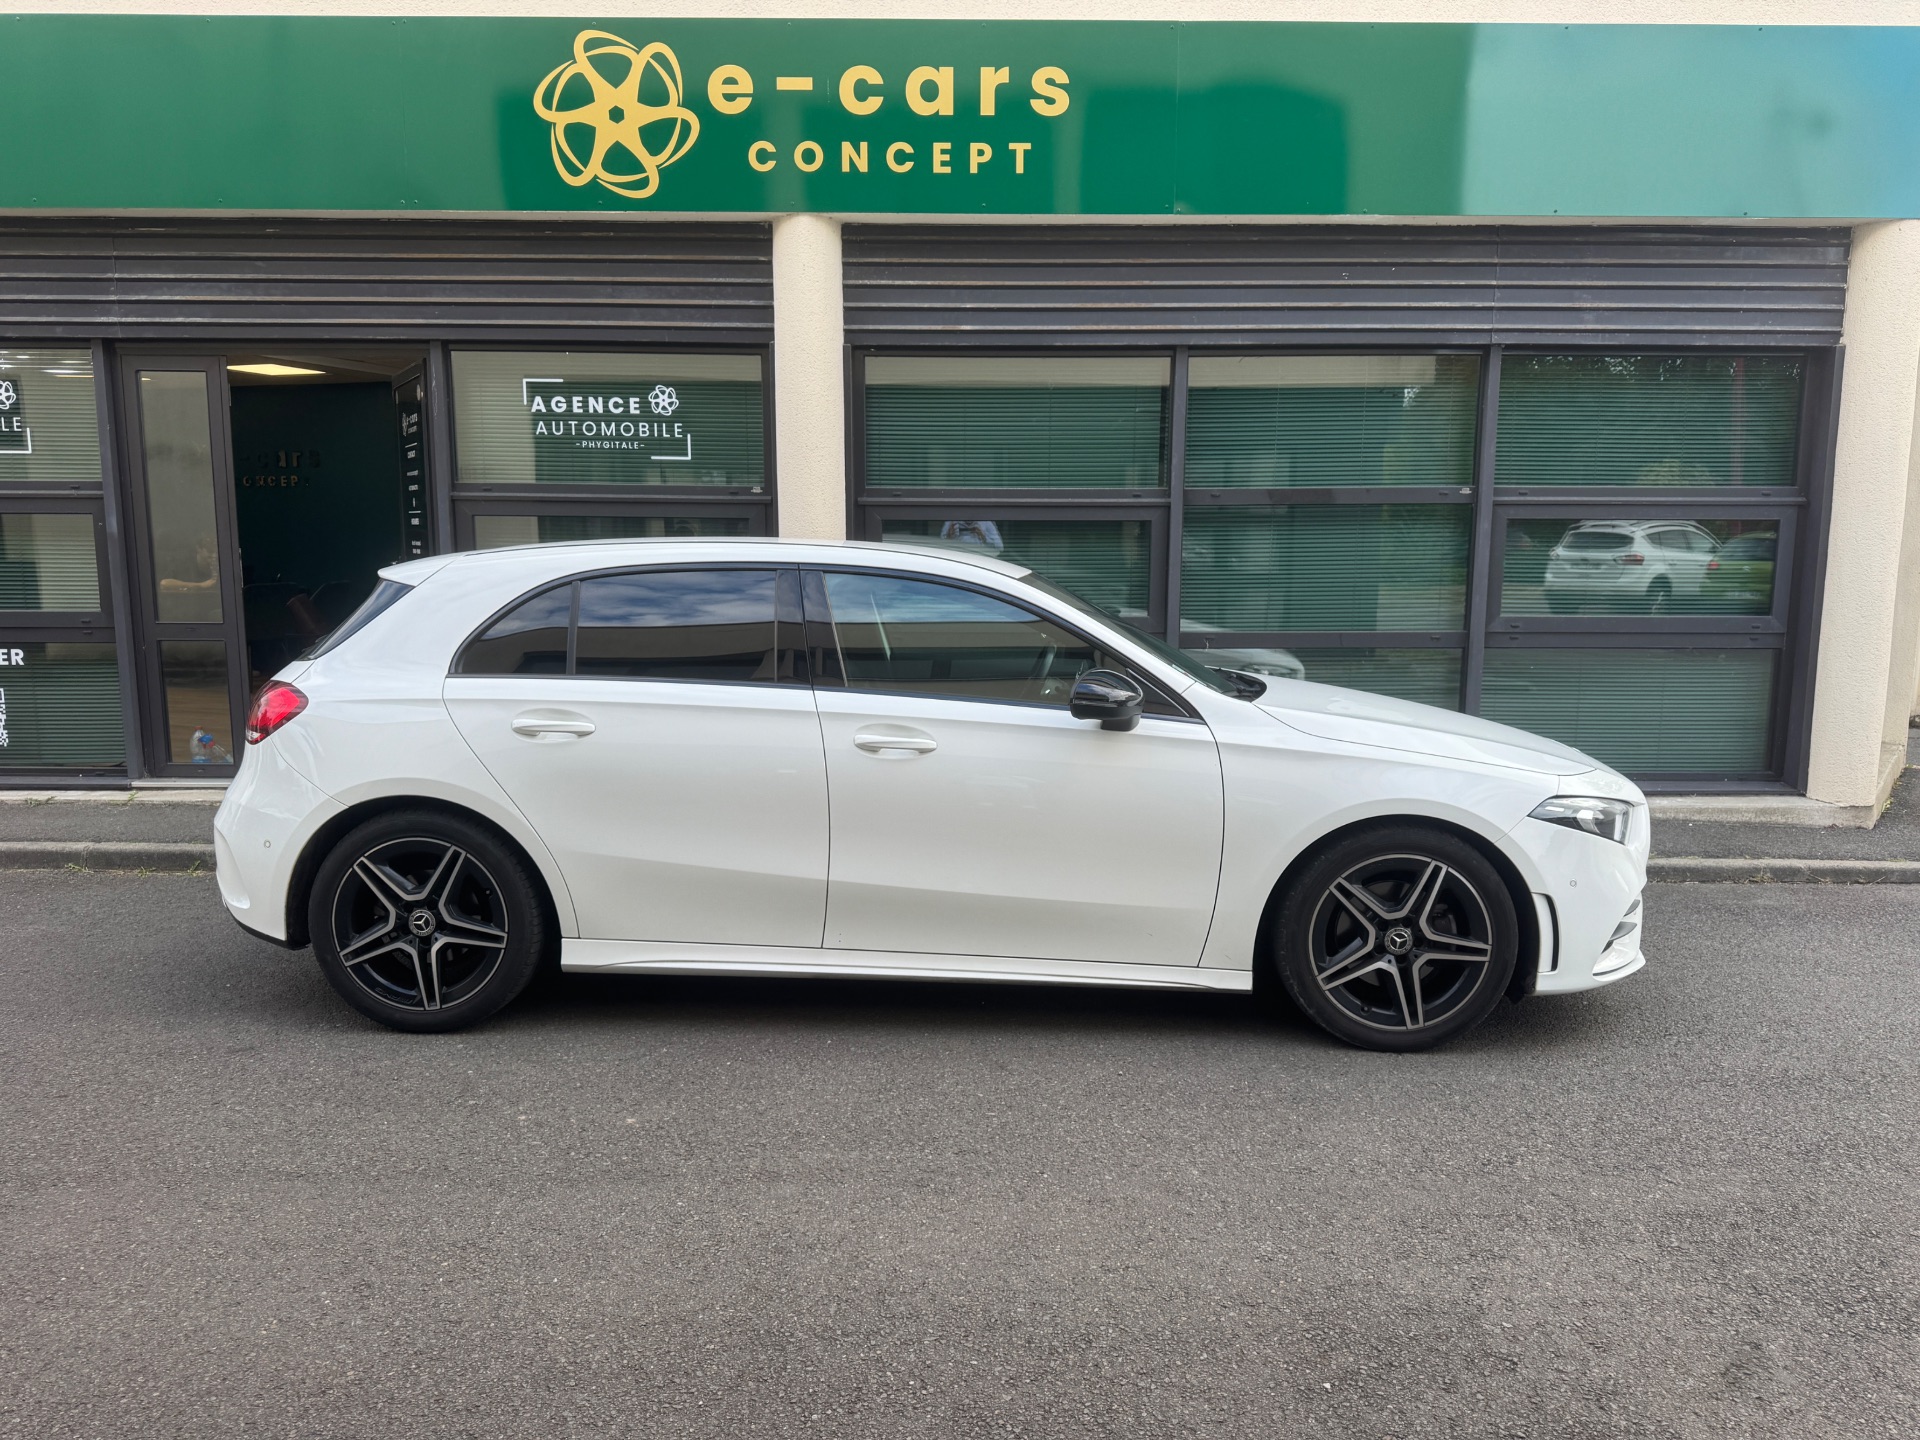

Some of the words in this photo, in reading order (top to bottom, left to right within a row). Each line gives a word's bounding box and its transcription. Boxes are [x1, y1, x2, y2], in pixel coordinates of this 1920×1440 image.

[707, 64, 1071, 117] e-cars
[747, 140, 1032, 174] CONCEPT
[530, 395, 641, 415] AGENCE
[535, 420, 684, 438] AUTOMOBILE
